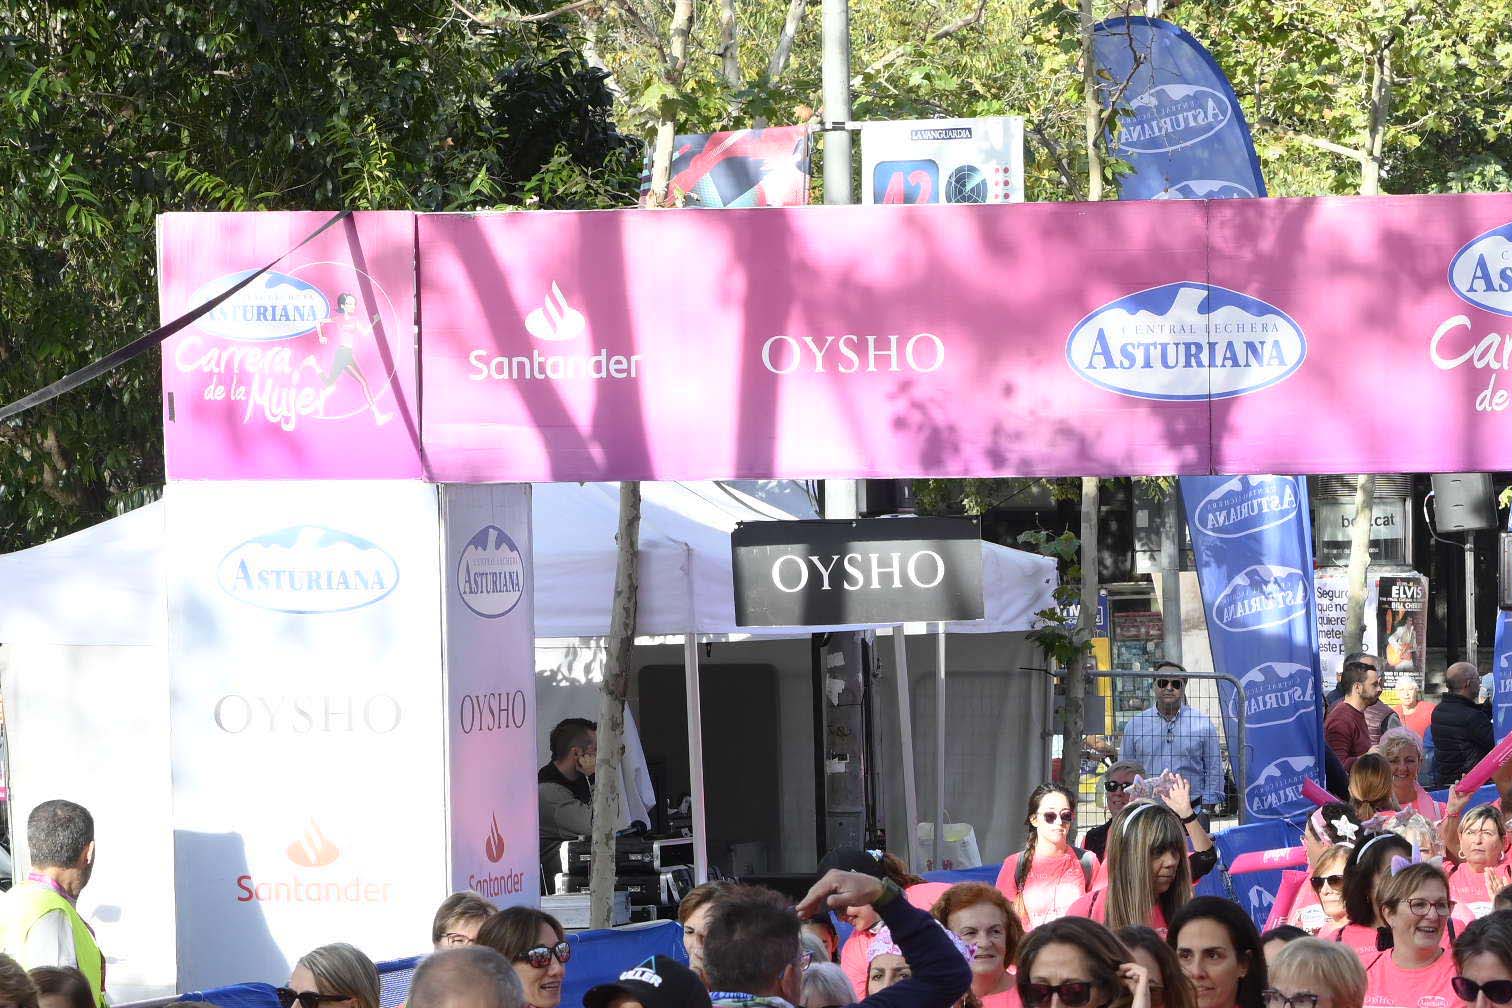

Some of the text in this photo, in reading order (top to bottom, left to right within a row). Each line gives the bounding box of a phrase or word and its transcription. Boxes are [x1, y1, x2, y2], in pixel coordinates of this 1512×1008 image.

[1121, 322, 1197, 337] CENTRAL
[174, 335, 294, 374] Carrera
[469, 348, 642, 381] Santander
[760, 332, 945, 375] OYSHO
[1084, 333, 1289, 371] ASTURIANA
[203, 366, 338, 432] de la Mujer
[1474, 374, 1510, 414] de
[231, 557, 388, 593] ASTURIANA
[462, 562, 521, 595] ASTURIANA
[771, 550, 946, 593] OYSHO
[1317, 603, 1334, 615] que
[1391, 585, 1424, 599] ELVIS
[1317, 614, 1350, 628] quiere
[1318, 643, 1338, 653] este
[213, 694, 403, 735] OYSHO
[460, 689, 526, 735] OYSHO
[236, 874, 391, 903] Santander
[469, 867, 524, 898] Santander
